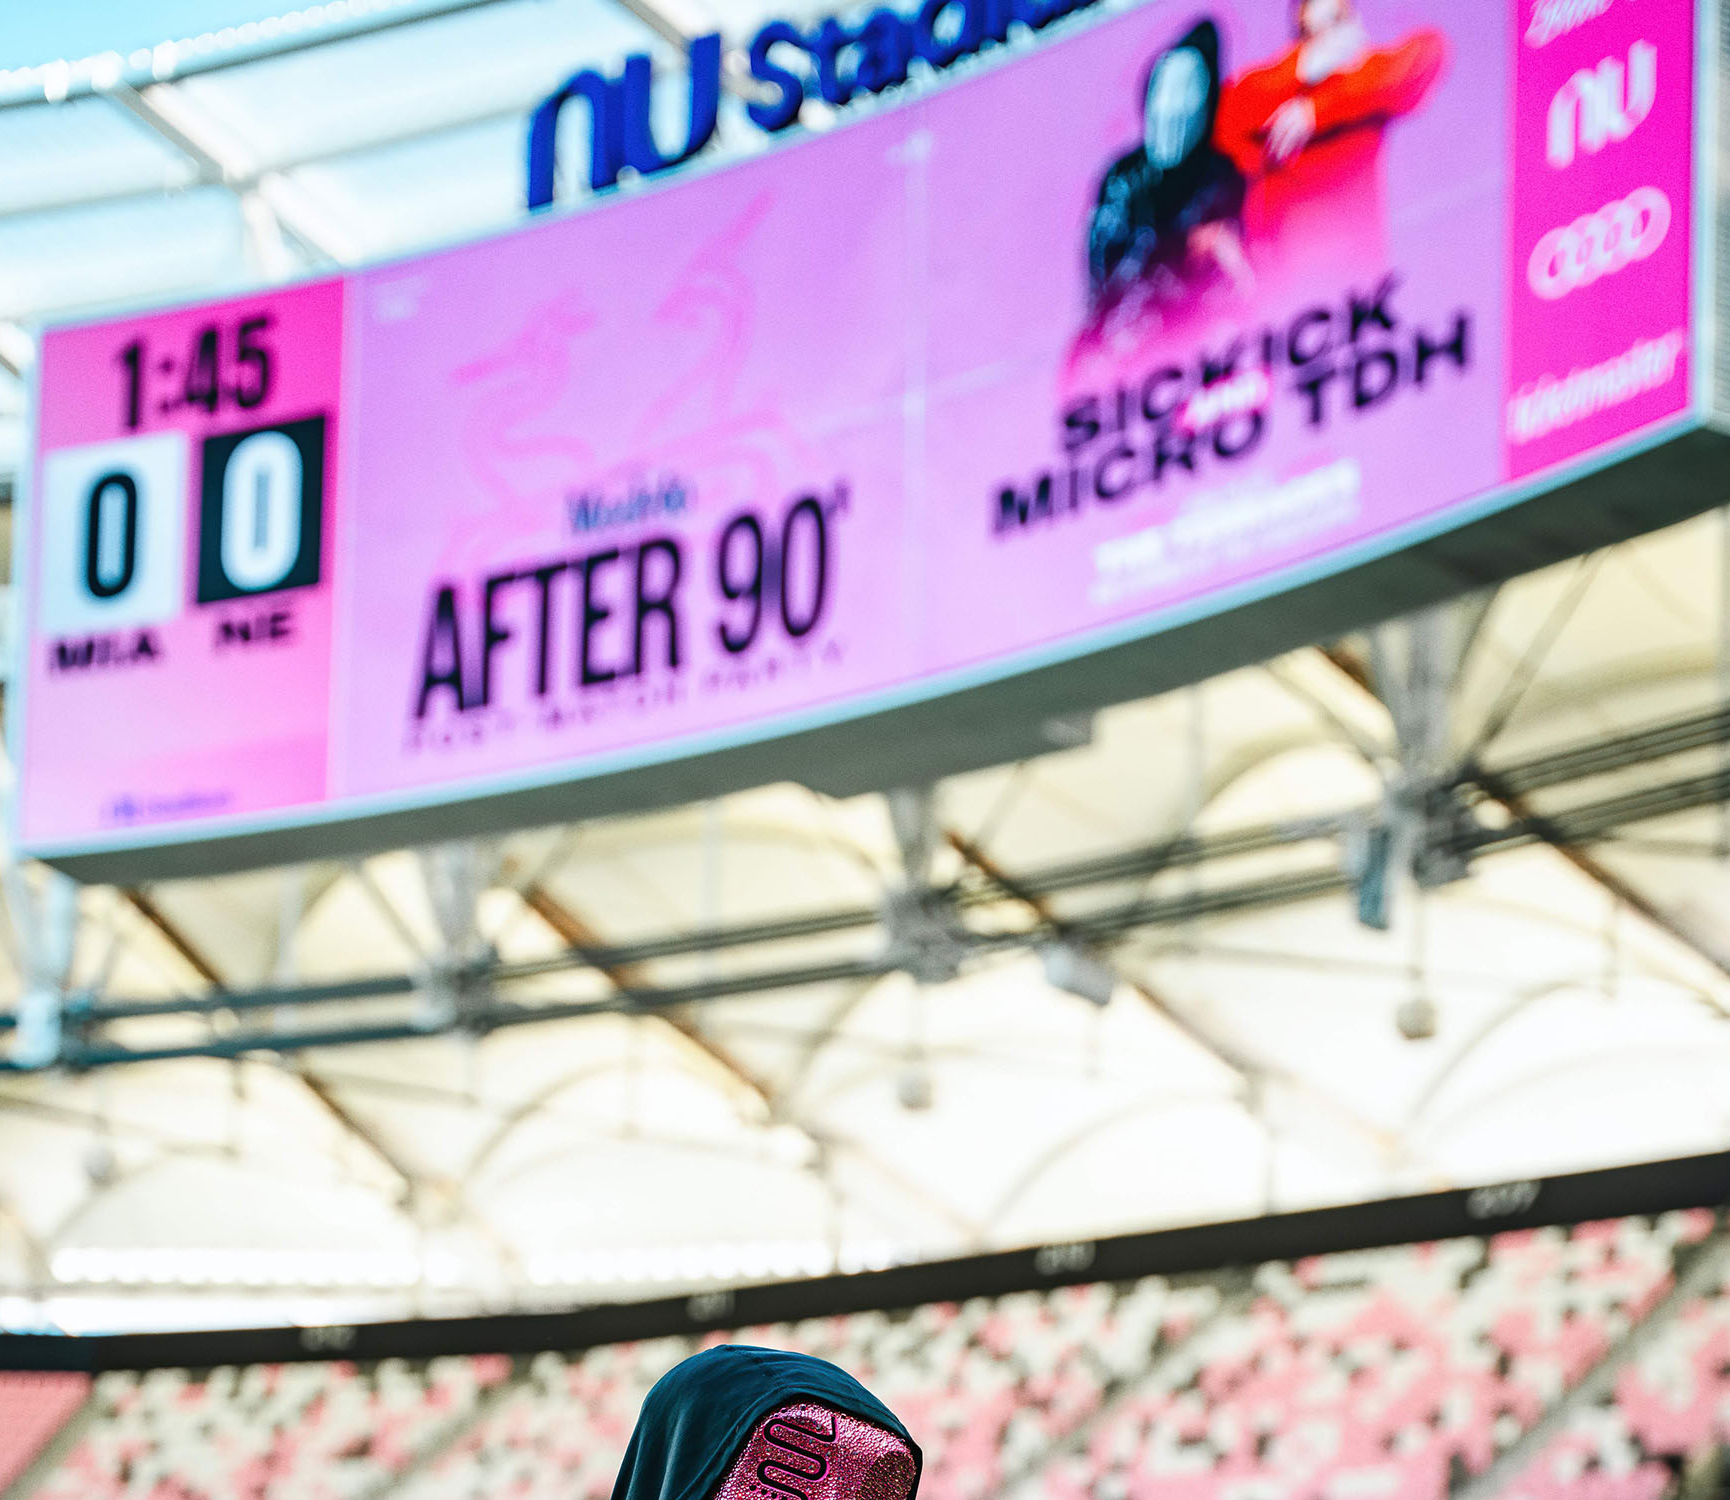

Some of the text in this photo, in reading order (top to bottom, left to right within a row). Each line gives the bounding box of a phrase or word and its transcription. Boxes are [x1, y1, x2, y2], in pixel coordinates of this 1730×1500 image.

[115, 315, 274, 430] 1:45
[990, 405, 1266, 540] MICRO
[1300, 311, 1473, 430] TDH
[1062, 272, 1405, 453] SICKICK
[87, 429, 304, 599] 0 0
[413, 537, 682, 722] AFTER
